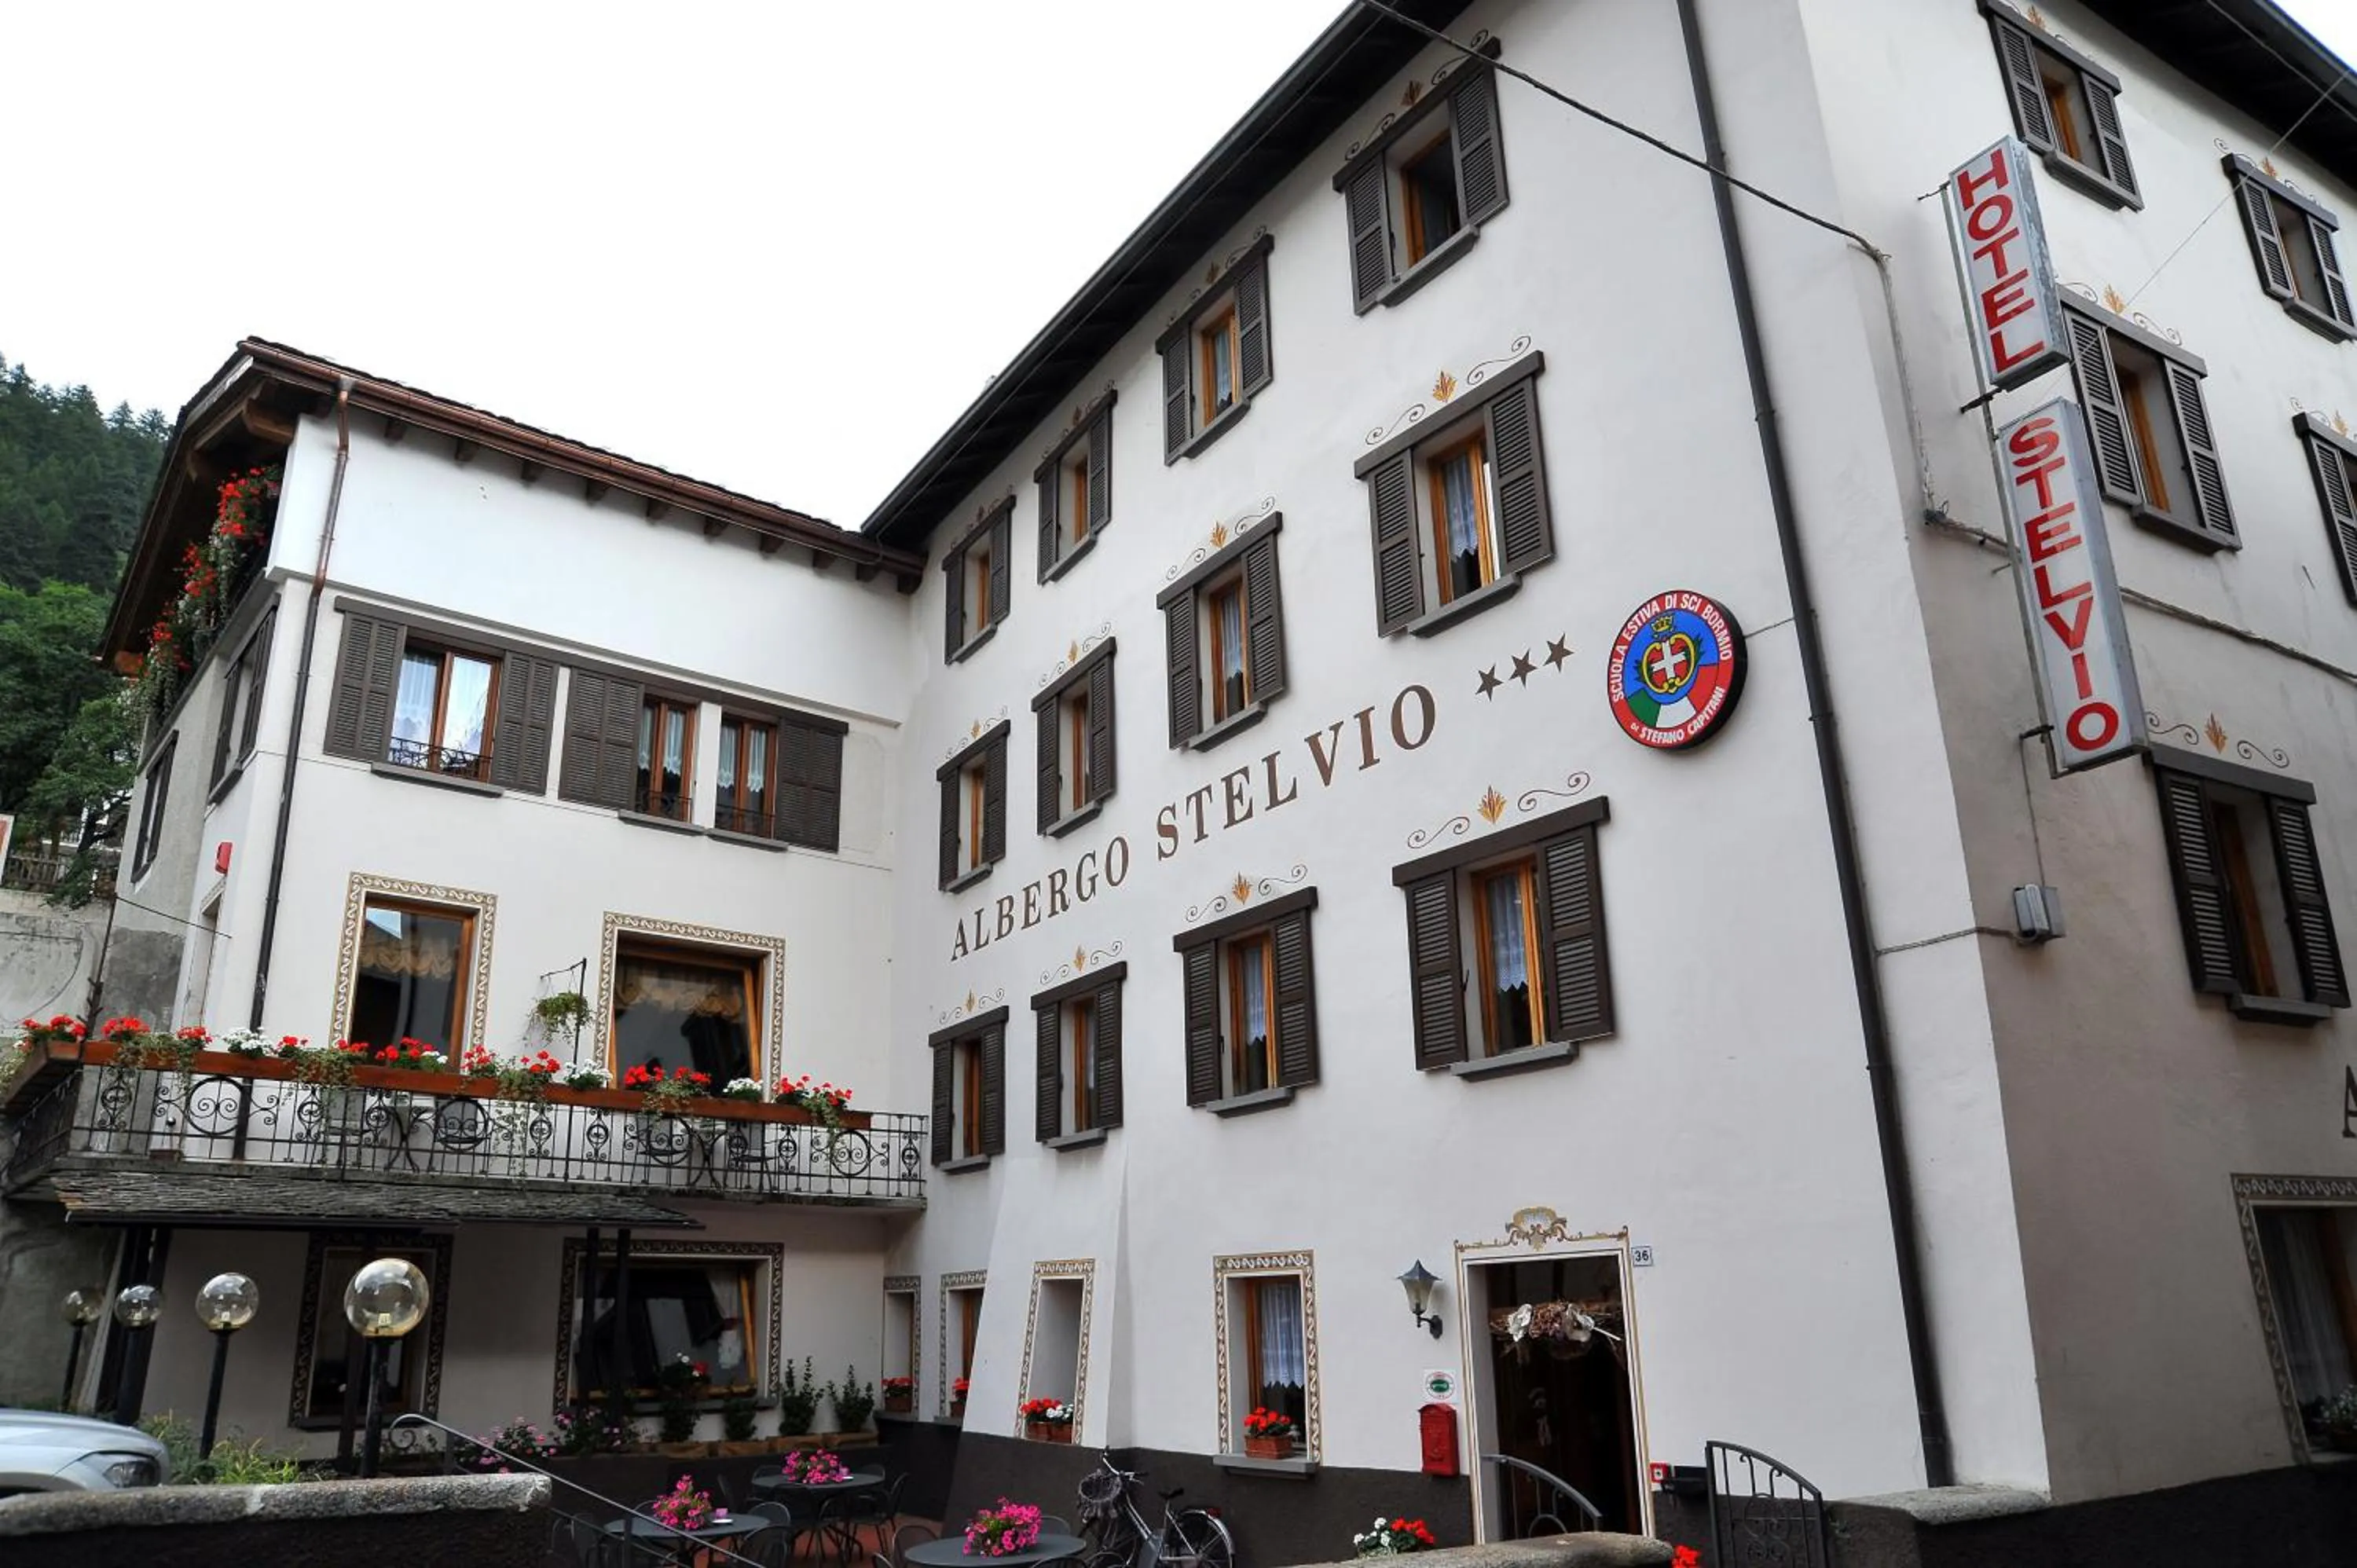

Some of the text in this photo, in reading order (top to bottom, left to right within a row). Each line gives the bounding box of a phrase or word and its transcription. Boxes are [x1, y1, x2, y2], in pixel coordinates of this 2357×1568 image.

[1957, 148, 2044, 373] HOTEL
[1611, 593, 1732, 702] SCUOLA ESTIVA DI SCI BORMIO
[2010, 417, 2119, 751] STELVIO
[950, 683, 1437, 962] ALBERGO STELVIO
[1639, 727, 1684, 745] STEFANO
[1687, 686, 1726, 735] CAPITANI
